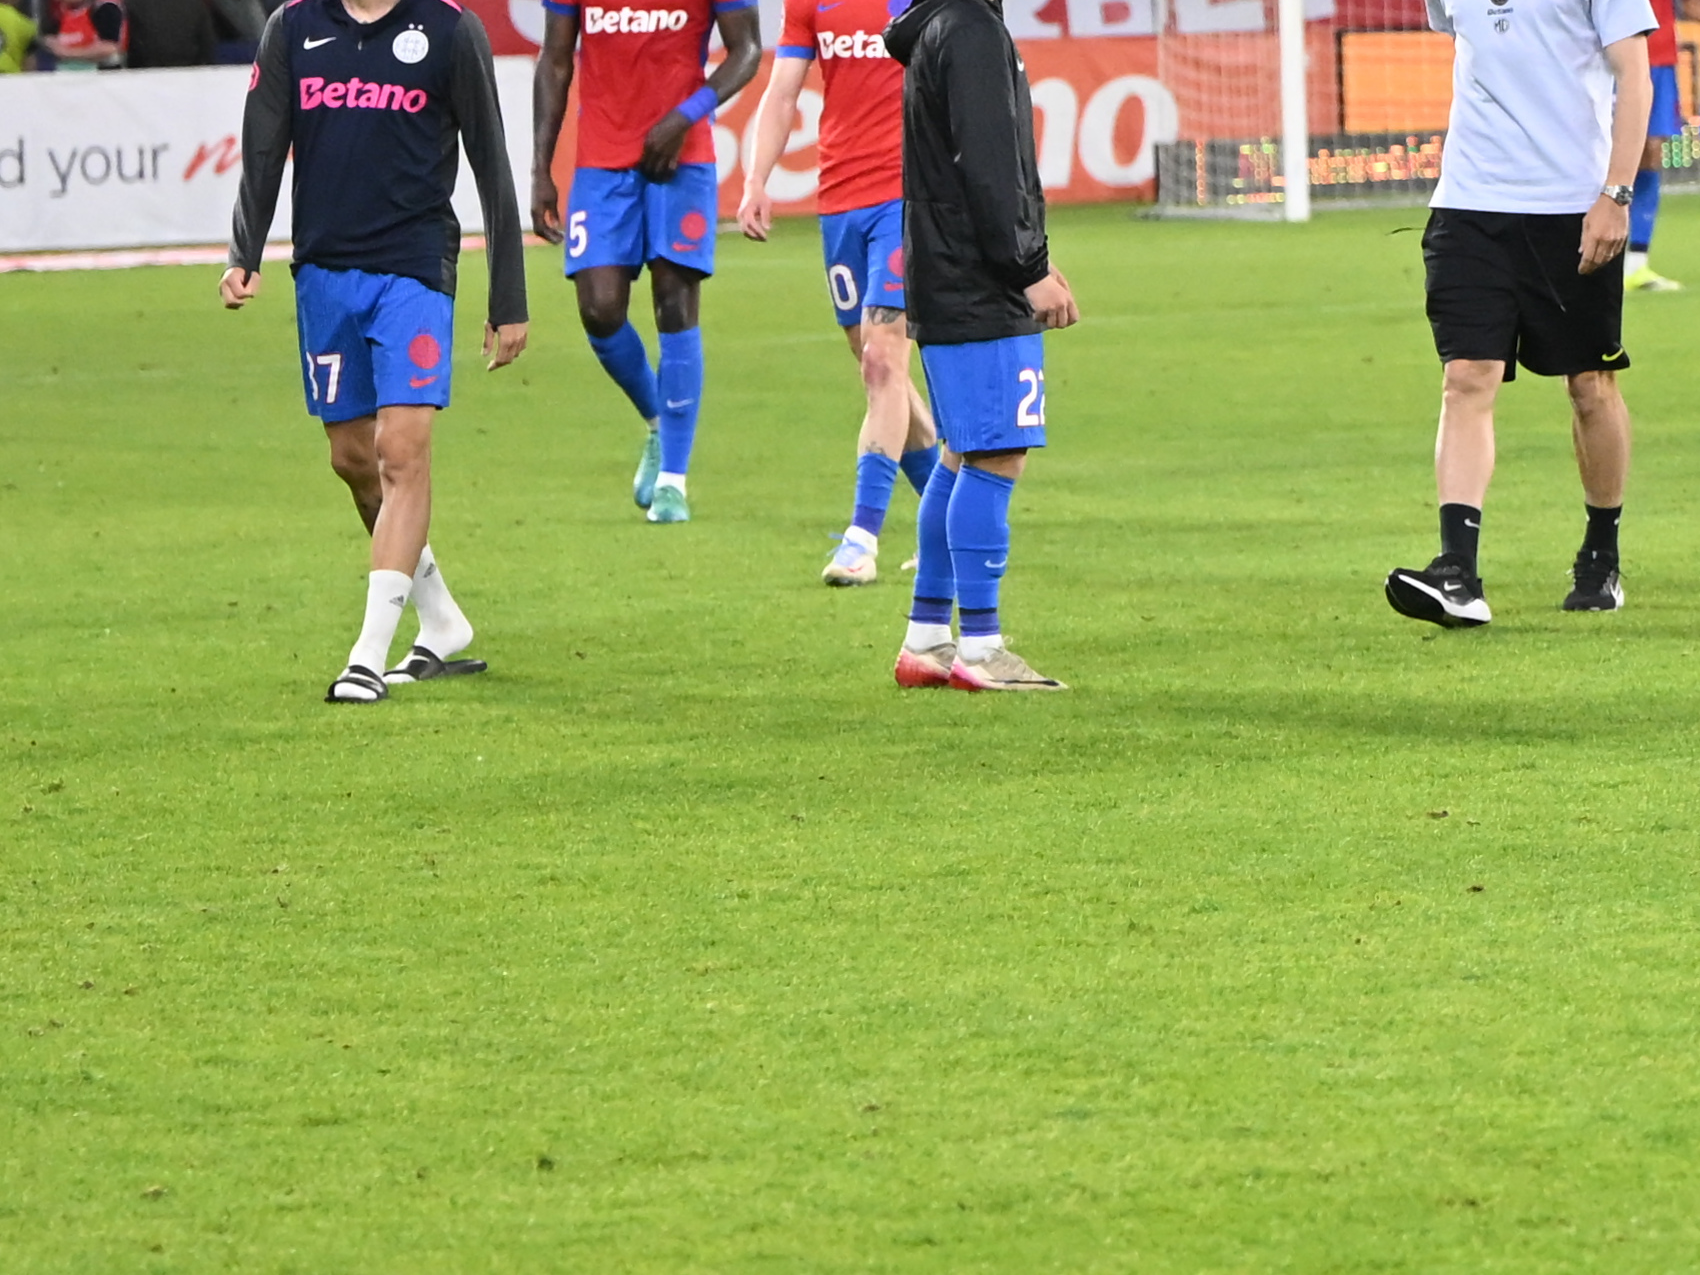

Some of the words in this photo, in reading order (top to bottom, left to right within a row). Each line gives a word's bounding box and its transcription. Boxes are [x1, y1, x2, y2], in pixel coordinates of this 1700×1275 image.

[585, 6, 688, 34] Betano
[816, 29, 893, 60] Beta
[300, 77, 427, 114] Betano
[47, 143, 170, 198] your
[568, 210, 588, 258] 5
